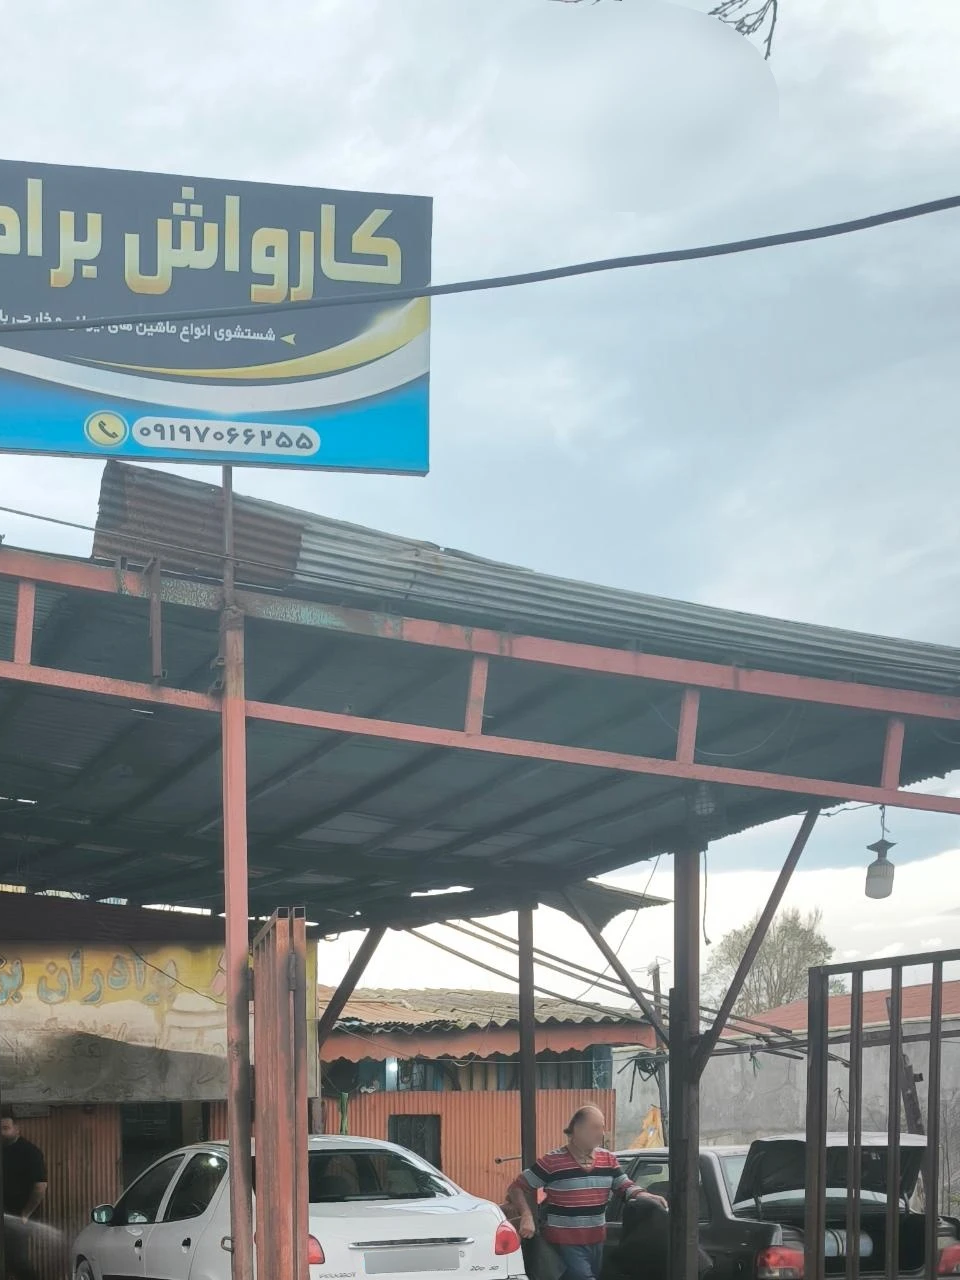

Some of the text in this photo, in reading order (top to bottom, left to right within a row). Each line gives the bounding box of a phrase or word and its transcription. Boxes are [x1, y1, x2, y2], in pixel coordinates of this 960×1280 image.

[124, 186, 402, 303] کارواش
[135, 320, 177, 337] ماشین
[179, 323, 212, 343] انواع
[214, 325, 276, 343] شستشوی
[139, 423, 314, 450] ۰۹۱۹۷۰۶۶۲۵۵
